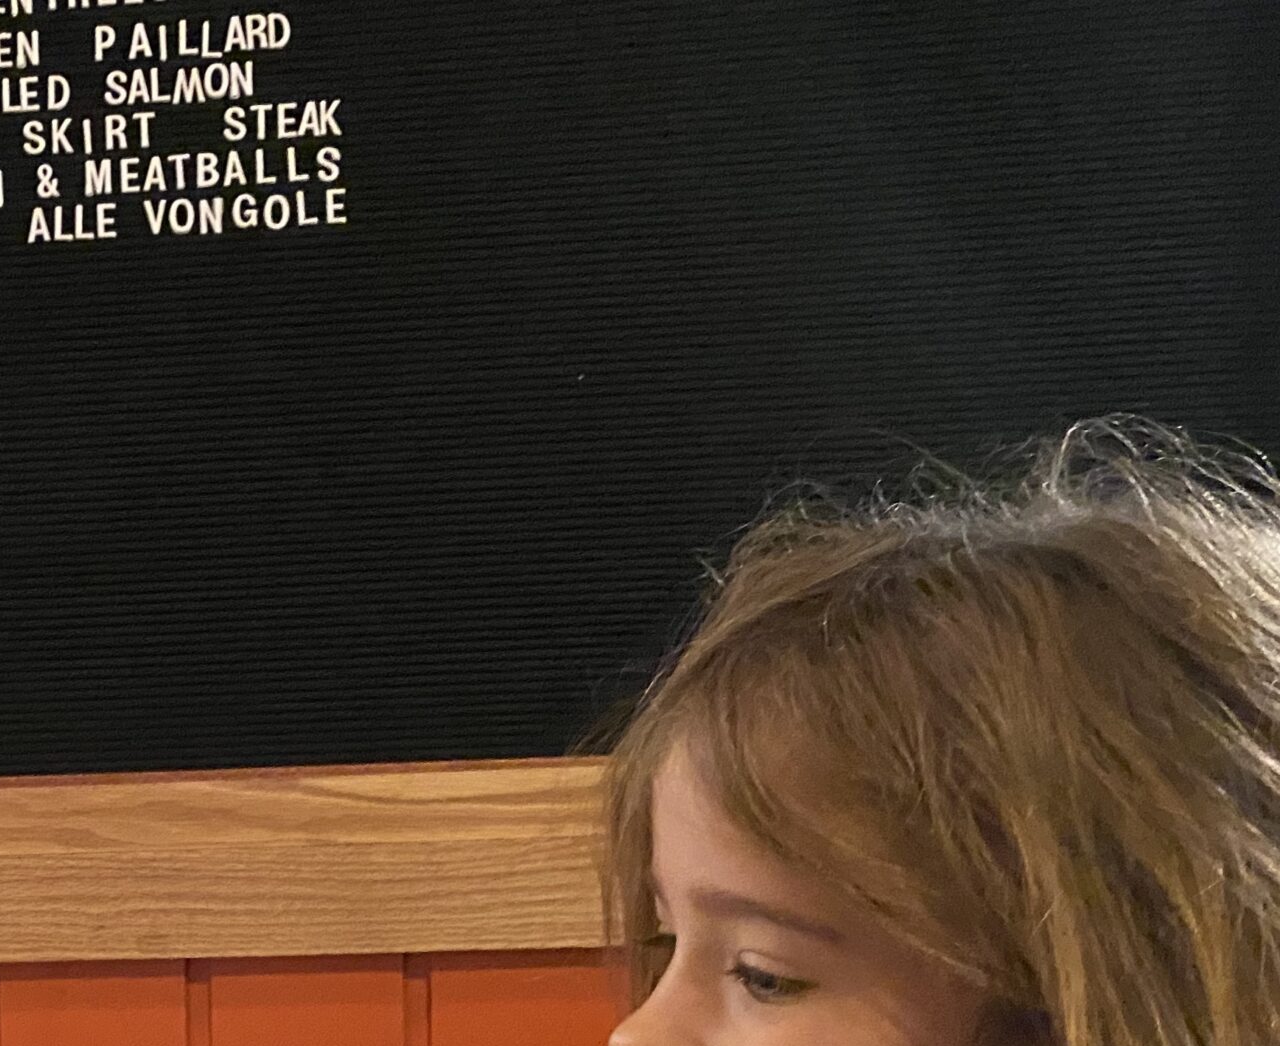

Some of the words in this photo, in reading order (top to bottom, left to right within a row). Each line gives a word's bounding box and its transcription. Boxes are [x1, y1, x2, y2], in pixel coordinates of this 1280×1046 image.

[94, 12, 291, 62] PAILLARD
[104, 60, 254, 105] SALMON
[22, 111, 156, 155] SKIRT
[223, 99, 342, 141] STEAK
[36, 163, 60, 199] &
[84, 146, 341, 197] MEATBALLS
[27, 203, 118, 244] ALLE
[143, 188, 348, 239] VONGOLE
